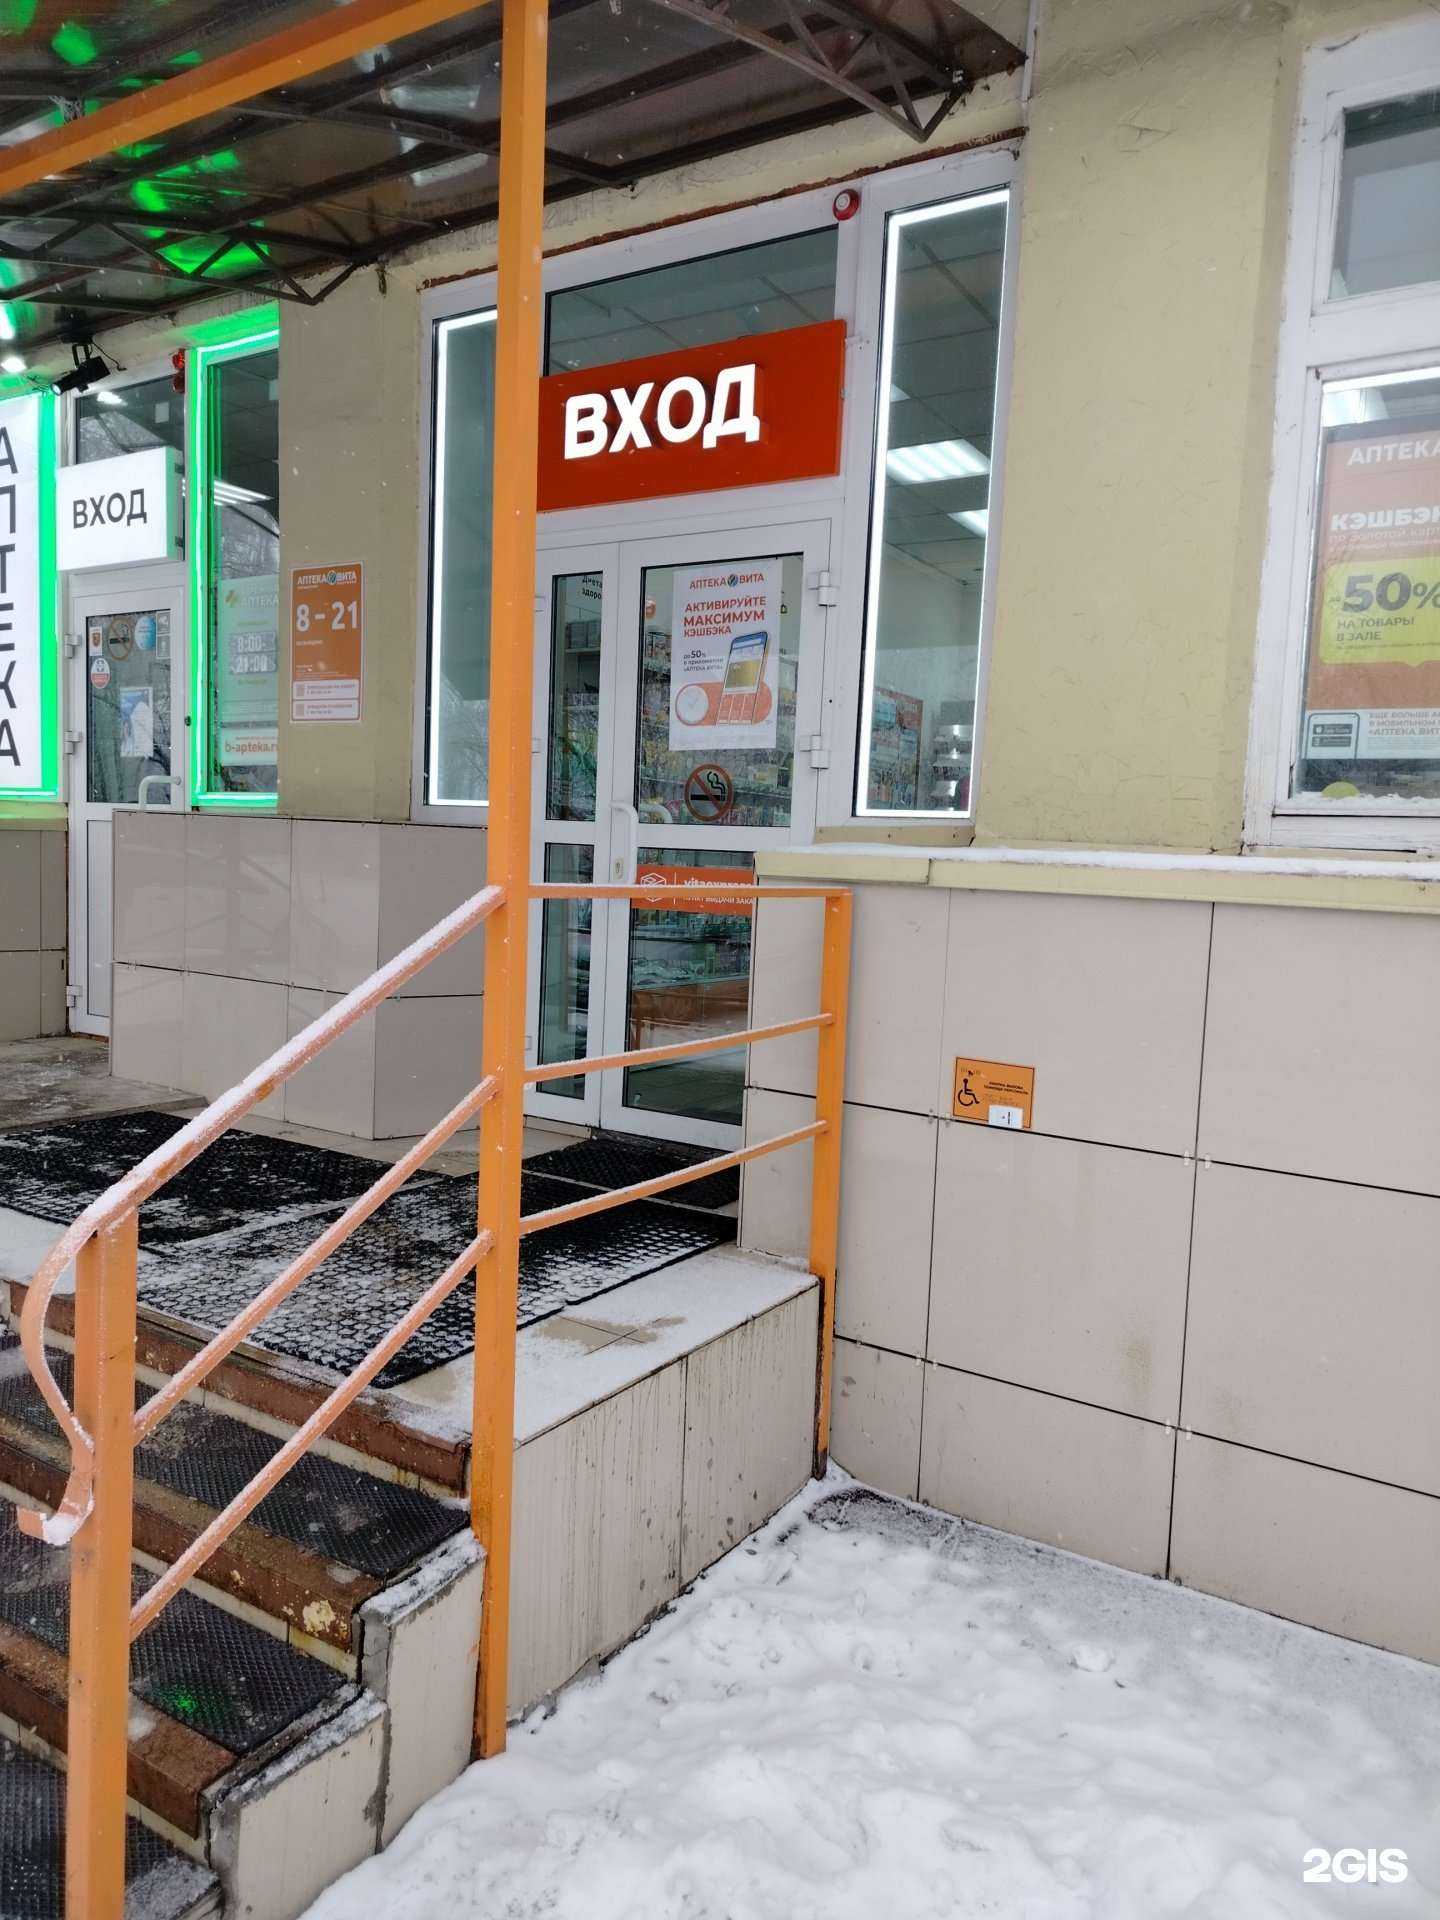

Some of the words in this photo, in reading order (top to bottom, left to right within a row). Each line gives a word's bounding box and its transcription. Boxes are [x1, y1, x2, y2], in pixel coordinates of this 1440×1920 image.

[564, 363, 761, 460] ВХОД
[1346, 438, 1440, 466] АПТЕКА
[72, 488, 148, 529] ВХОД
[297, 573, 326, 585] АПТЕКА
[690, 577, 726, 590] АПТЕКА
[739, 573, 765, 584] ВИТА
[1342, 571, 1440, 613] 50%
[685, 595, 767, 613] АКТИВИРУЙТЕ
[297, 603, 310, 632] 8
[331, 600, 357, 630] 21
[684, 609, 765, 627] МАКСИМУМ
[1336, 619, 1355, 630] НА
[1358, 616, 1415, 628] ТОВАРЫ
[684, 626, 732, 637] КЭШБЭКА
[1348, 631, 1382, 641] ЗАЛЕ
